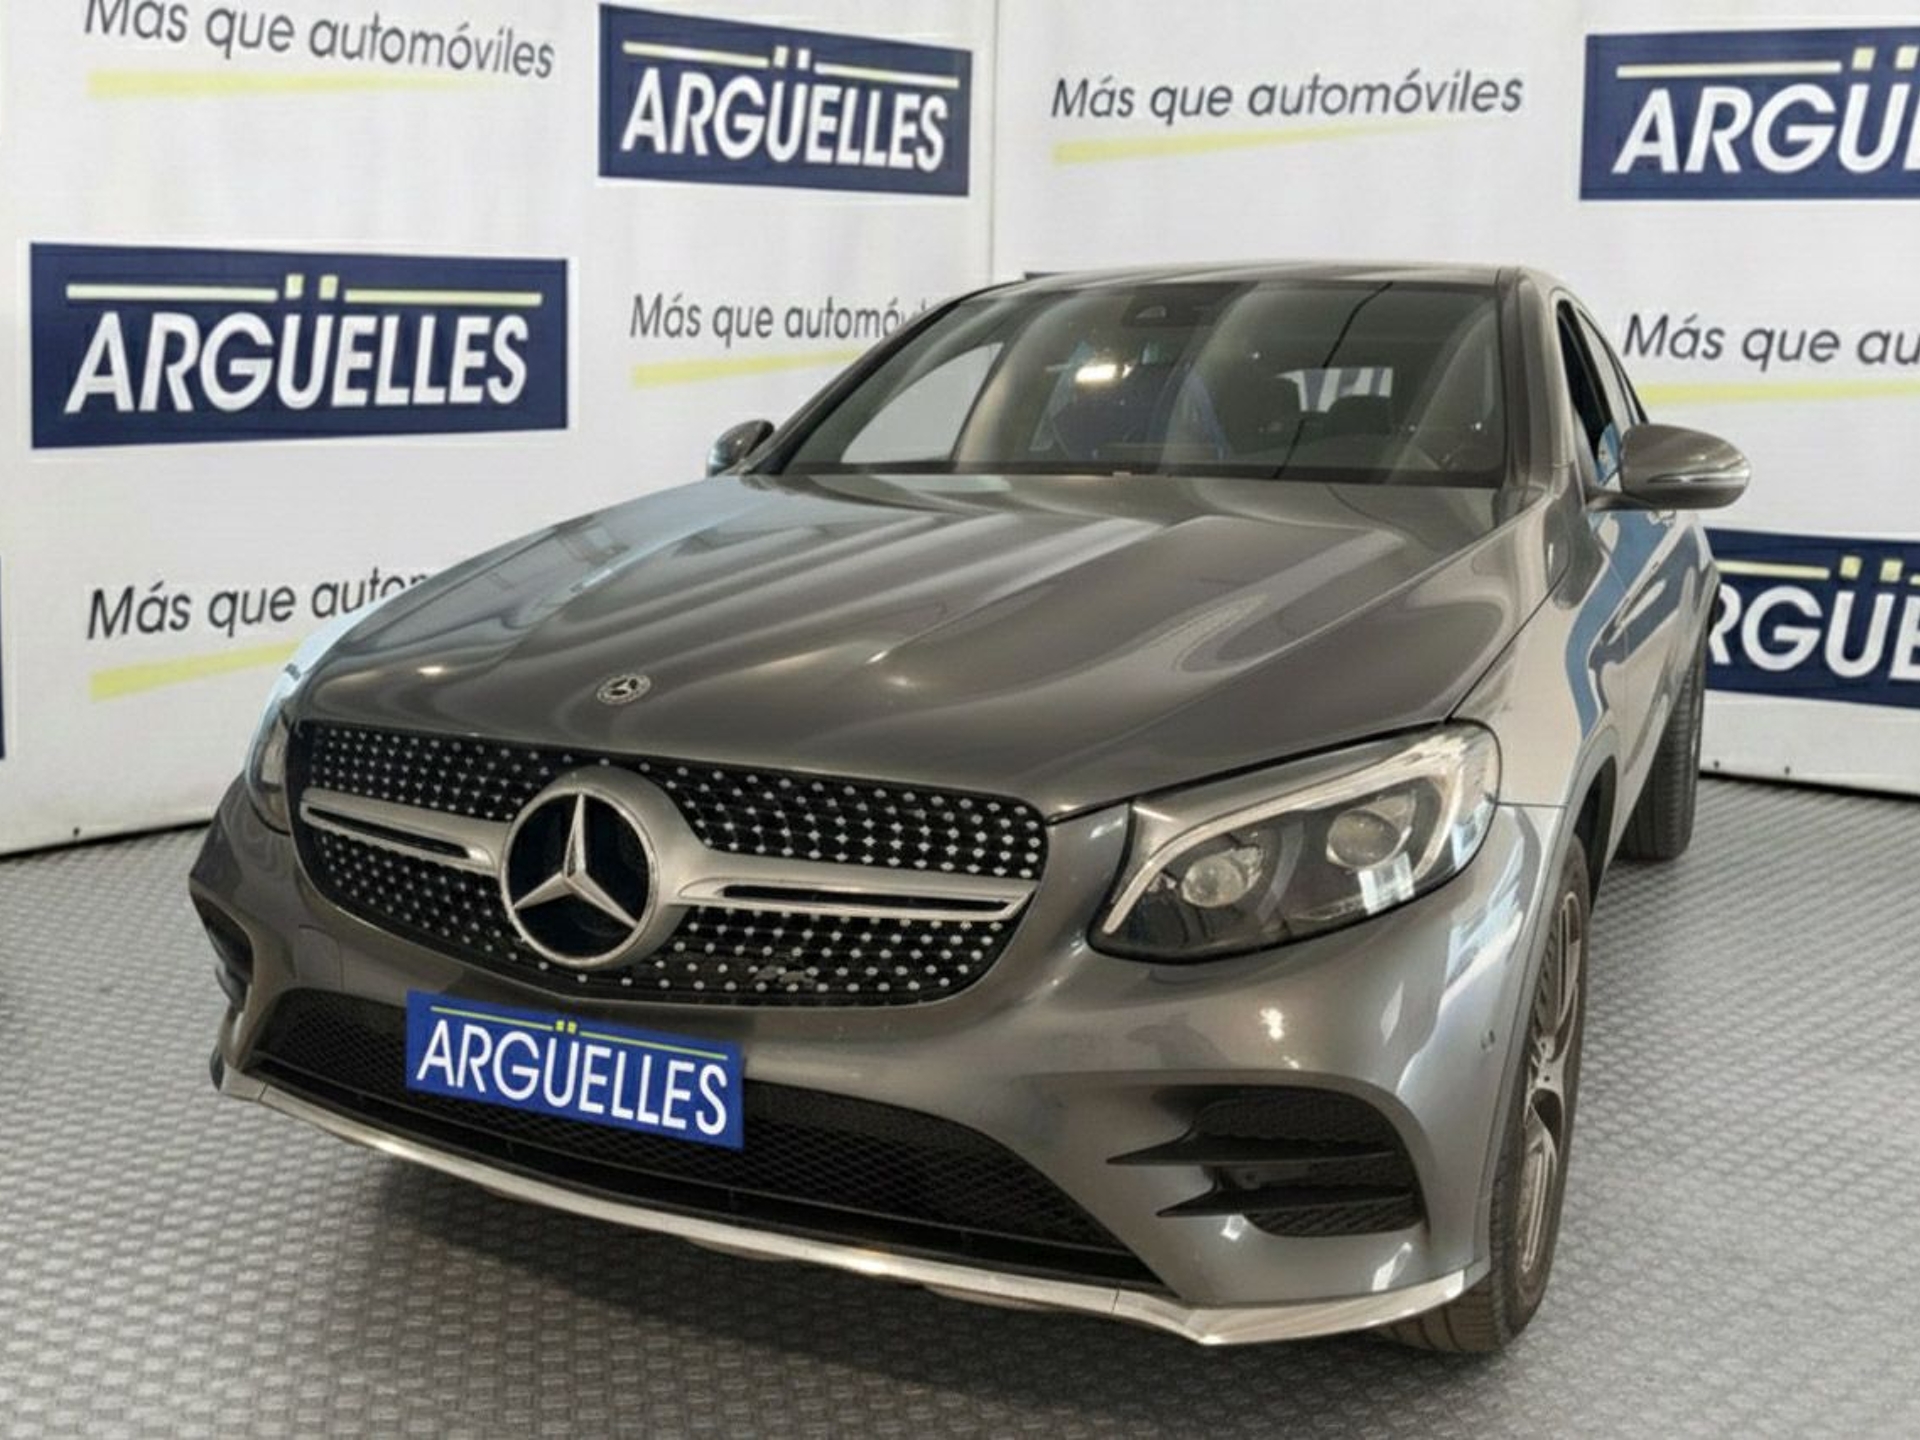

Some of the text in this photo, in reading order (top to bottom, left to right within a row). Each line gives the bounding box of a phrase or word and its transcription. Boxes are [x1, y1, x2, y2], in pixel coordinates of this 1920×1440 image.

[205, 8, 295, 59] que
[308, 14, 555, 78] automóviles
[620, 46, 949, 172] ARGÜELLES
[1051, 68, 1524, 126] Más que automóviles
[64, 274, 529, 413] ARGÜELLES
[630, 294, 928, 348] Más que automó
[1623, 314, 1920, 372] Más que au
[87, 582, 191, 640] Más
[207, 586, 296, 638] que
[1709, 554, 1920, 681] RGÜ
[416, 1019, 728, 1136] ARGÜELLES
